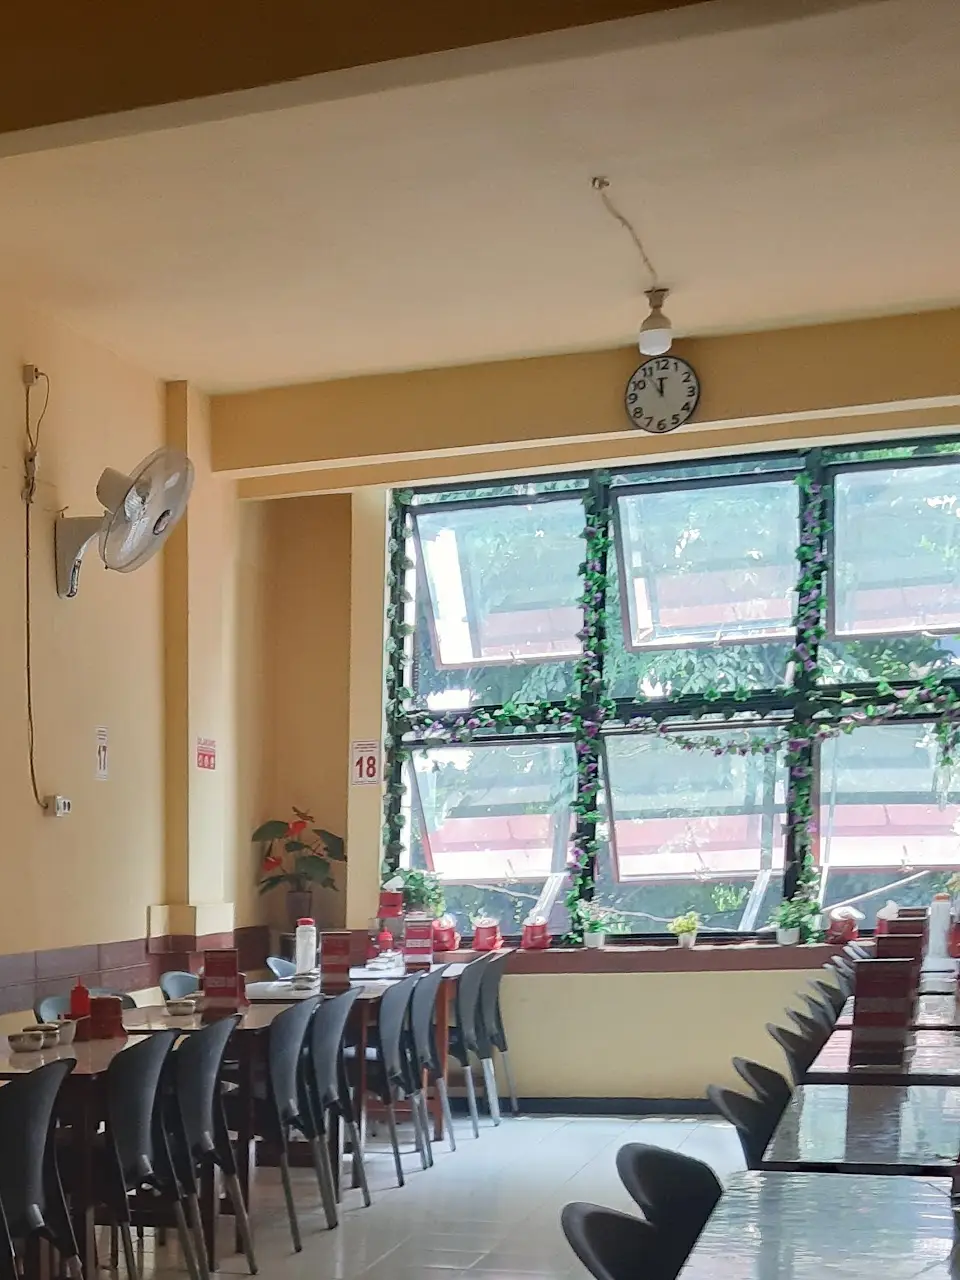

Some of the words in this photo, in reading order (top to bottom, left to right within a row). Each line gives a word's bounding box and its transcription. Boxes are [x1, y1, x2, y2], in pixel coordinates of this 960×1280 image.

[655, 359, 669, 370] 12
[673, 362, 679, 372] 1
[642, 366, 653, 377] 11
[681, 371, 691, 383] 2
[631, 380, 646, 391] 10
[687, 386, 696, 397] 3
[628, 392, 638, 404] 9
[633, 406, 644, 418] 8
[680, 401, 690, 412] 4
[644, 416, 654, 427] 7
[657, 418, 667, 430] 6
[671, 413, 681, 425] 5
[97, 744, 107, 770] 17
[355, 755, 377, 778] 18
